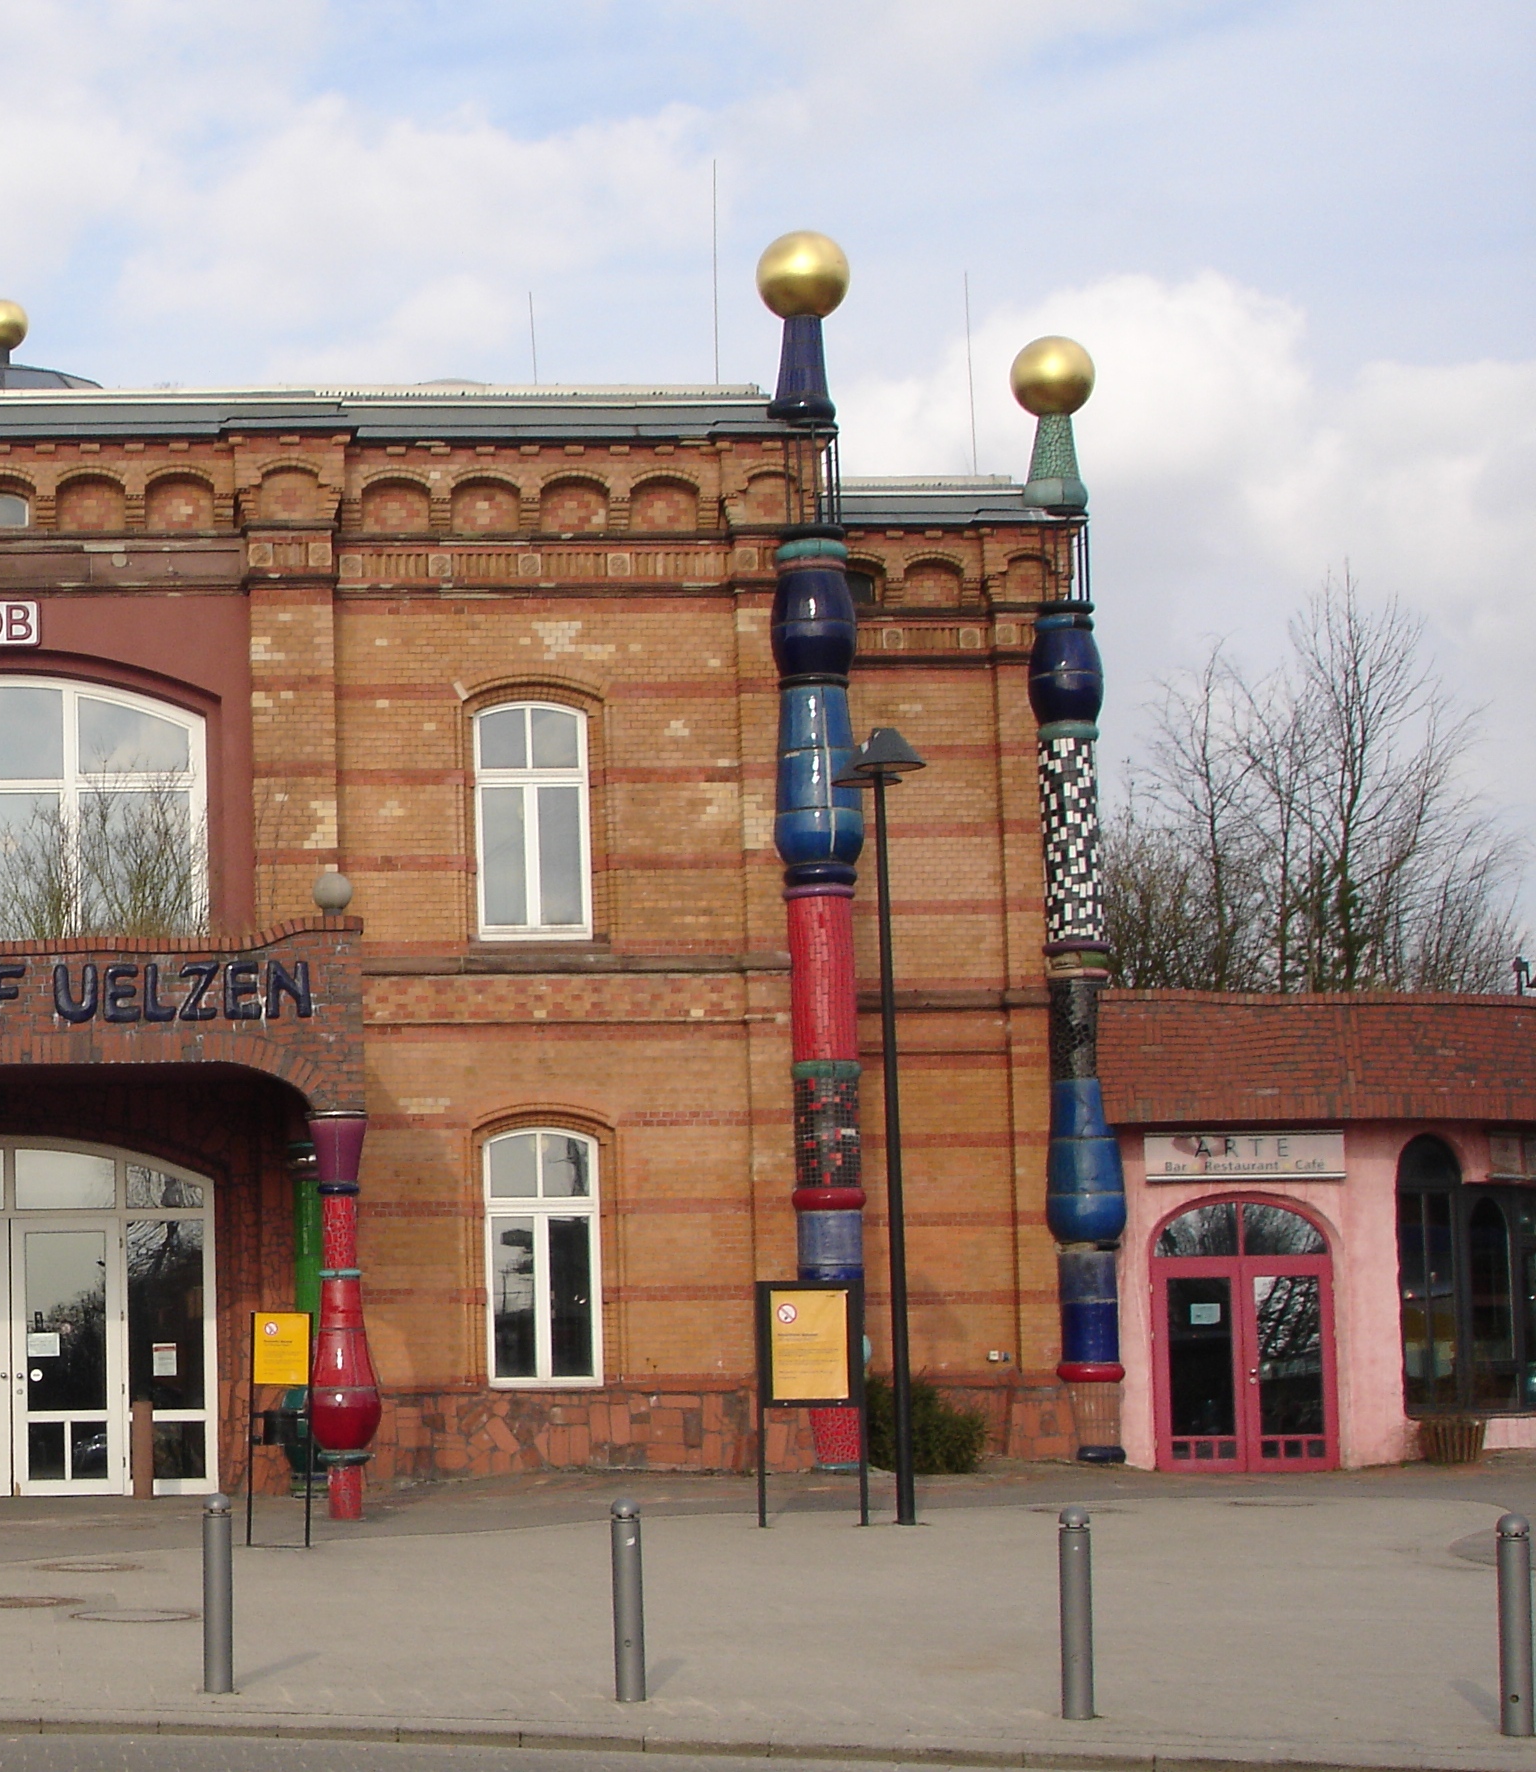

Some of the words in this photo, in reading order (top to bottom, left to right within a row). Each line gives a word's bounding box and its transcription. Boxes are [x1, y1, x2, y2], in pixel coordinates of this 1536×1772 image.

[52, 960, 313, 1023] UELZEN
[1194, 1137, 1289, 1158] ARTE
[1165, 1161, 1187, 1172] Bar
[1205, 1160, 1279, 1172] Restaurant
[1295, 1158, 1325, 1171] Café
